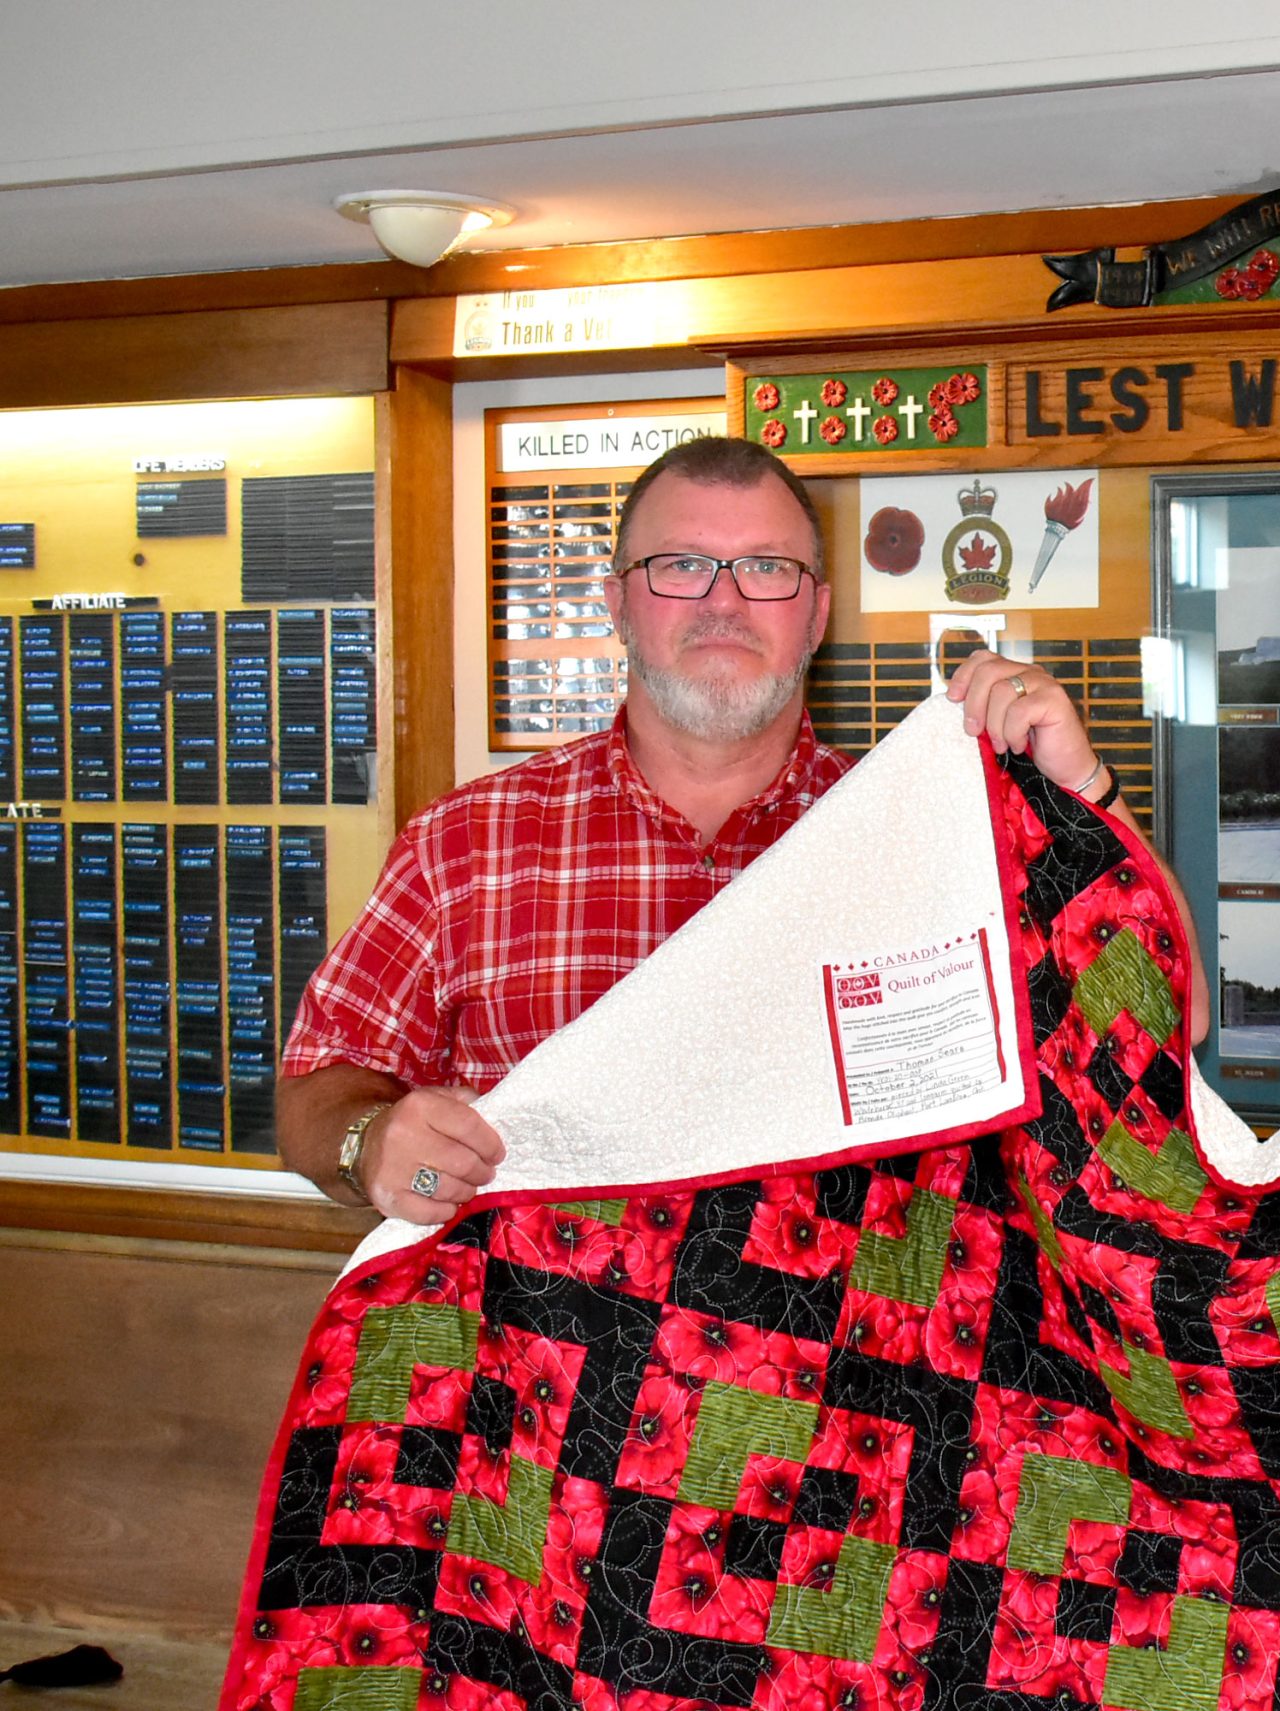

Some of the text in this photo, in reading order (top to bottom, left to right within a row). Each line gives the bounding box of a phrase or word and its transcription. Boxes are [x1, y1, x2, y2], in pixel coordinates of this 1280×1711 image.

[502, 320, 554, 345] Thank
[564, 322, 574, 342] a
[1025, 363, 1195, 438] LEST
[518, 433, 589, 456] KILLED
[600, 432, 619, 452] IN
[951, 574, 1003, 588] LEGION
[52, 592, 127, 610] AFFILIATE
[6, 803, 43, 818] ATE
[873, 945, 939, 968] CANADA
[887, 959, 975, 993] Quilt of Valour
[896, 1057, 934, 1070] Thomas
[865, 1082, 904, 1096] October
